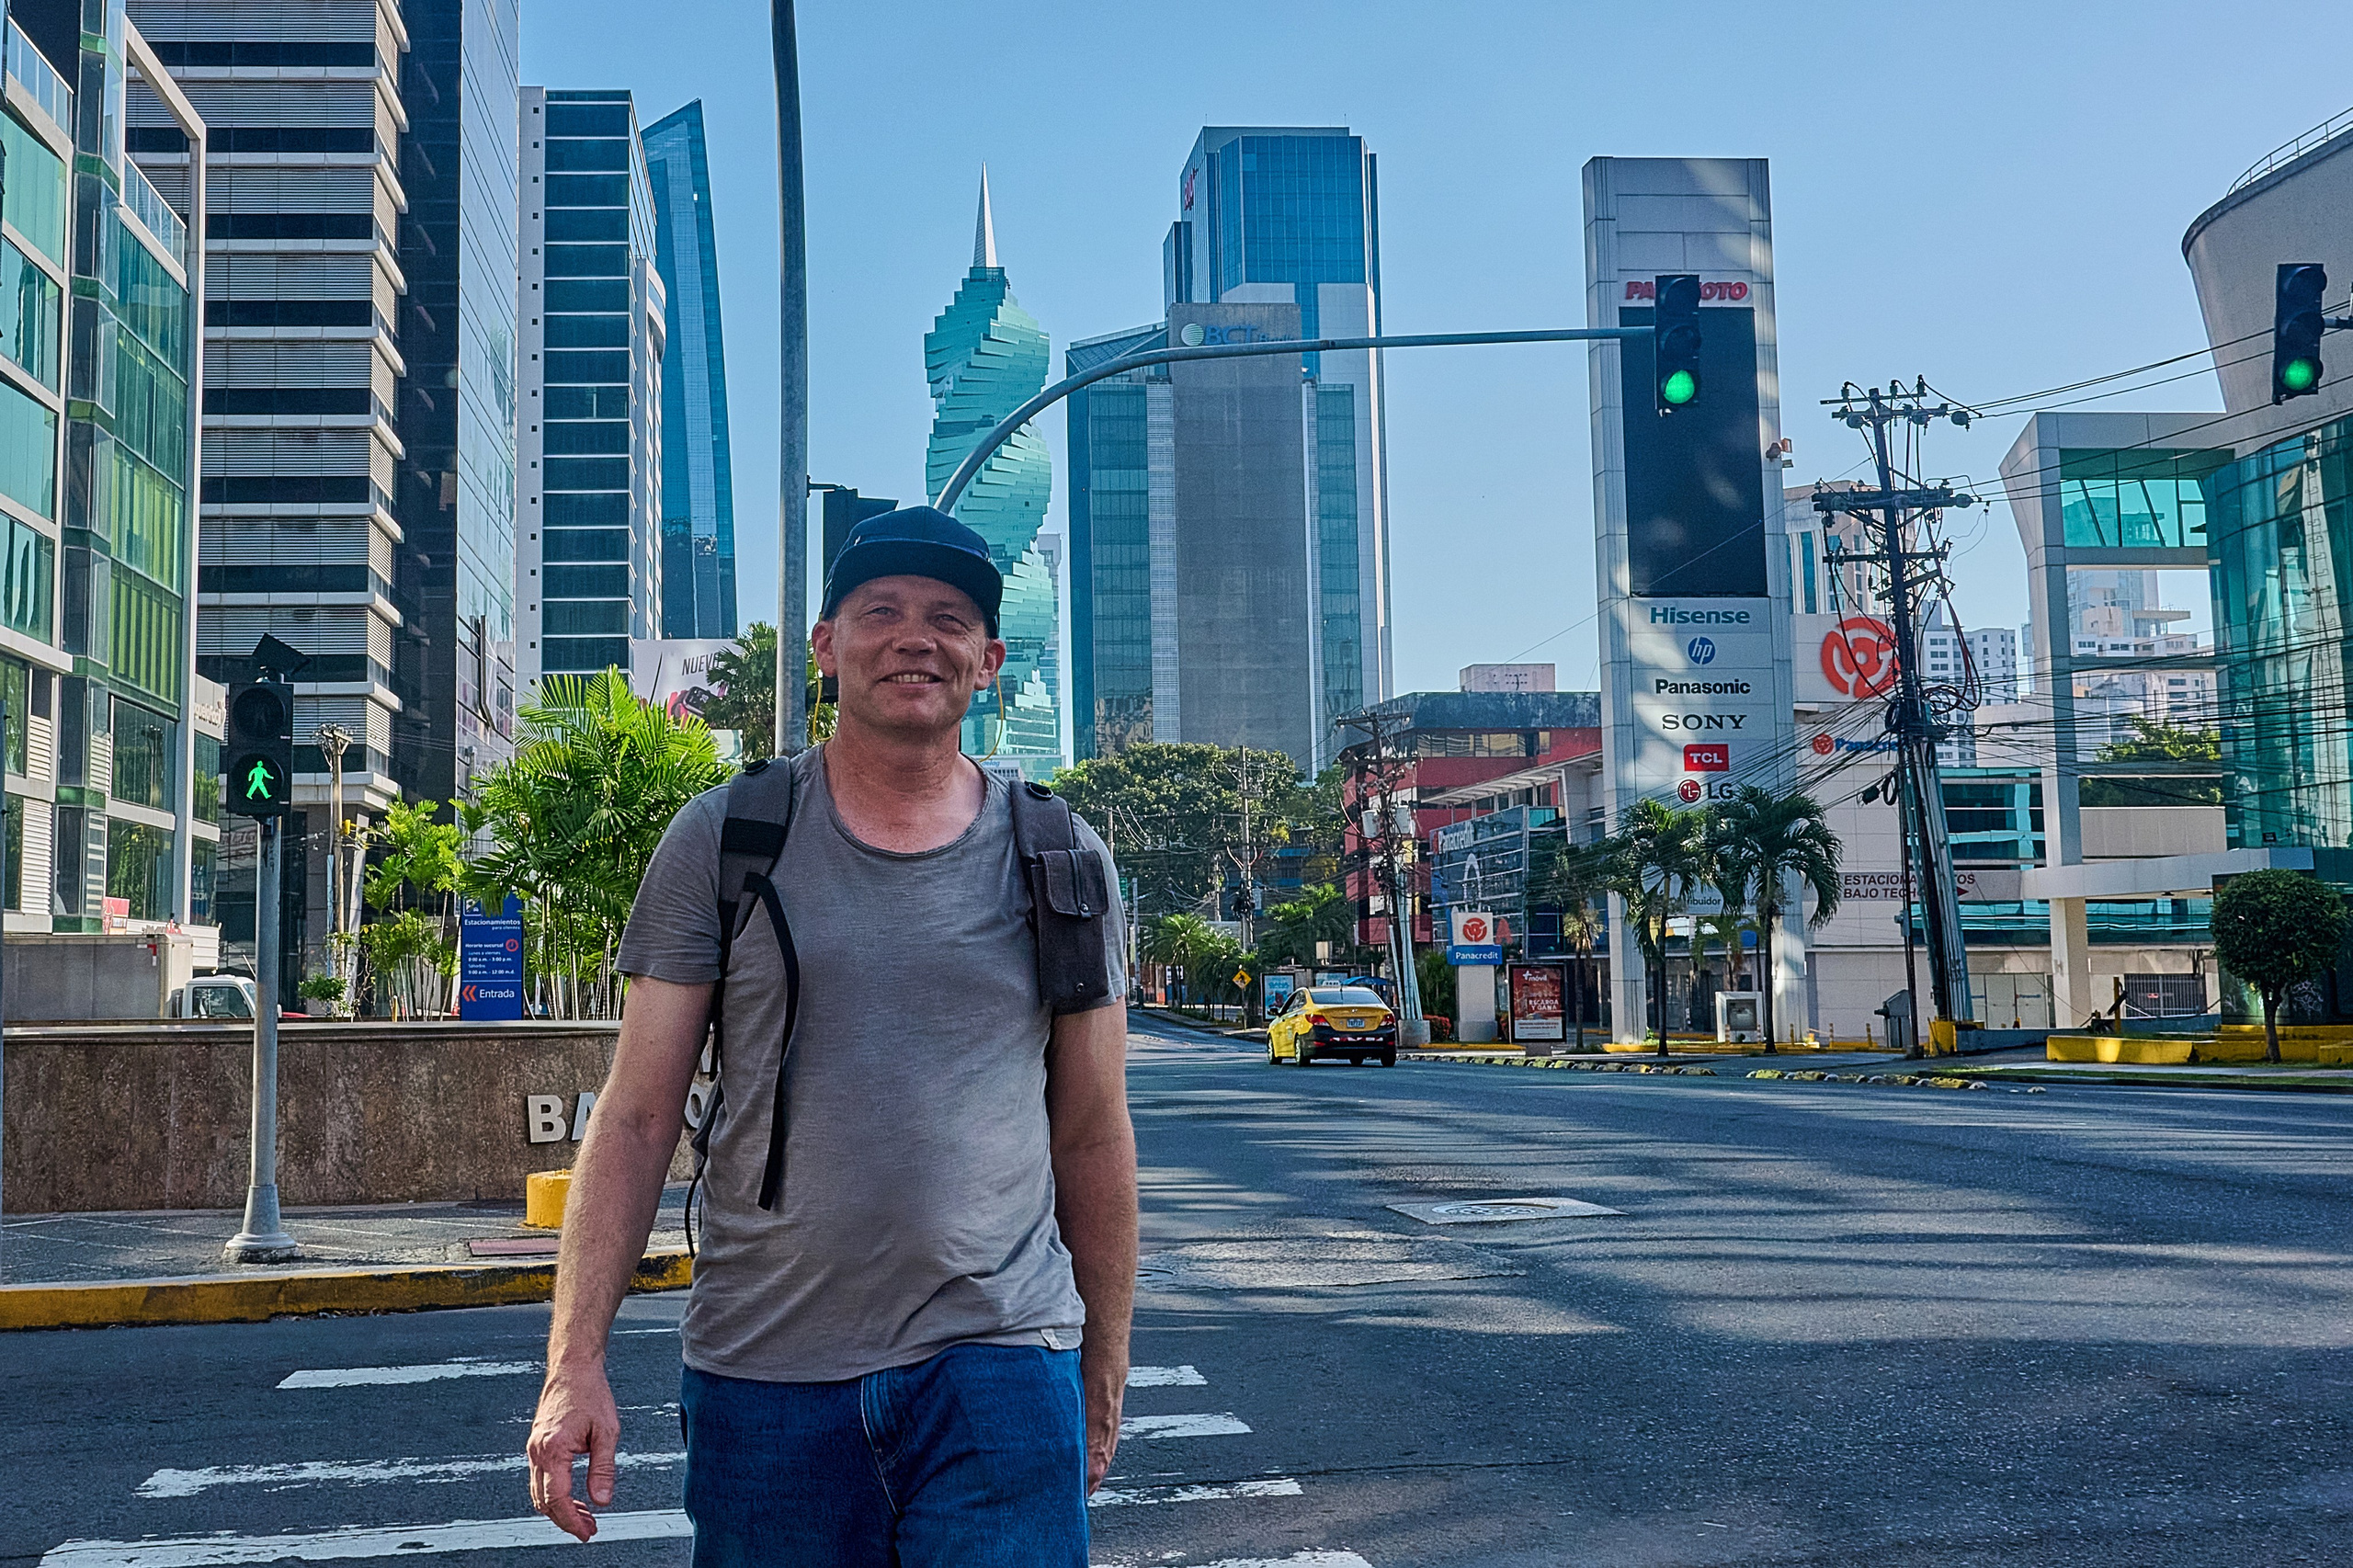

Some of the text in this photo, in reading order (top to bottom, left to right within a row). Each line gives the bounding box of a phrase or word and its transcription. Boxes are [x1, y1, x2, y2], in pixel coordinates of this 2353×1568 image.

[1625, 280, 1748, 301] PAOTO
[1204, 324, 1257, 346] BCT
[1650, 607, 1751, 624] Hisense
[1691, 637, 1713, 665] hp
[1654, 678, 1751, 695] Panasonic
[1662, 714, 1747, 730] SONY
[1689, 753, 1723, 764] TCL
[1707, 782, 1733, 800] LG
[1844, 888, 1927, 898] BAJO TECH
[1455, 951, 1498, 960] Panacredit
[479, 989, 515, 998] Entrada
